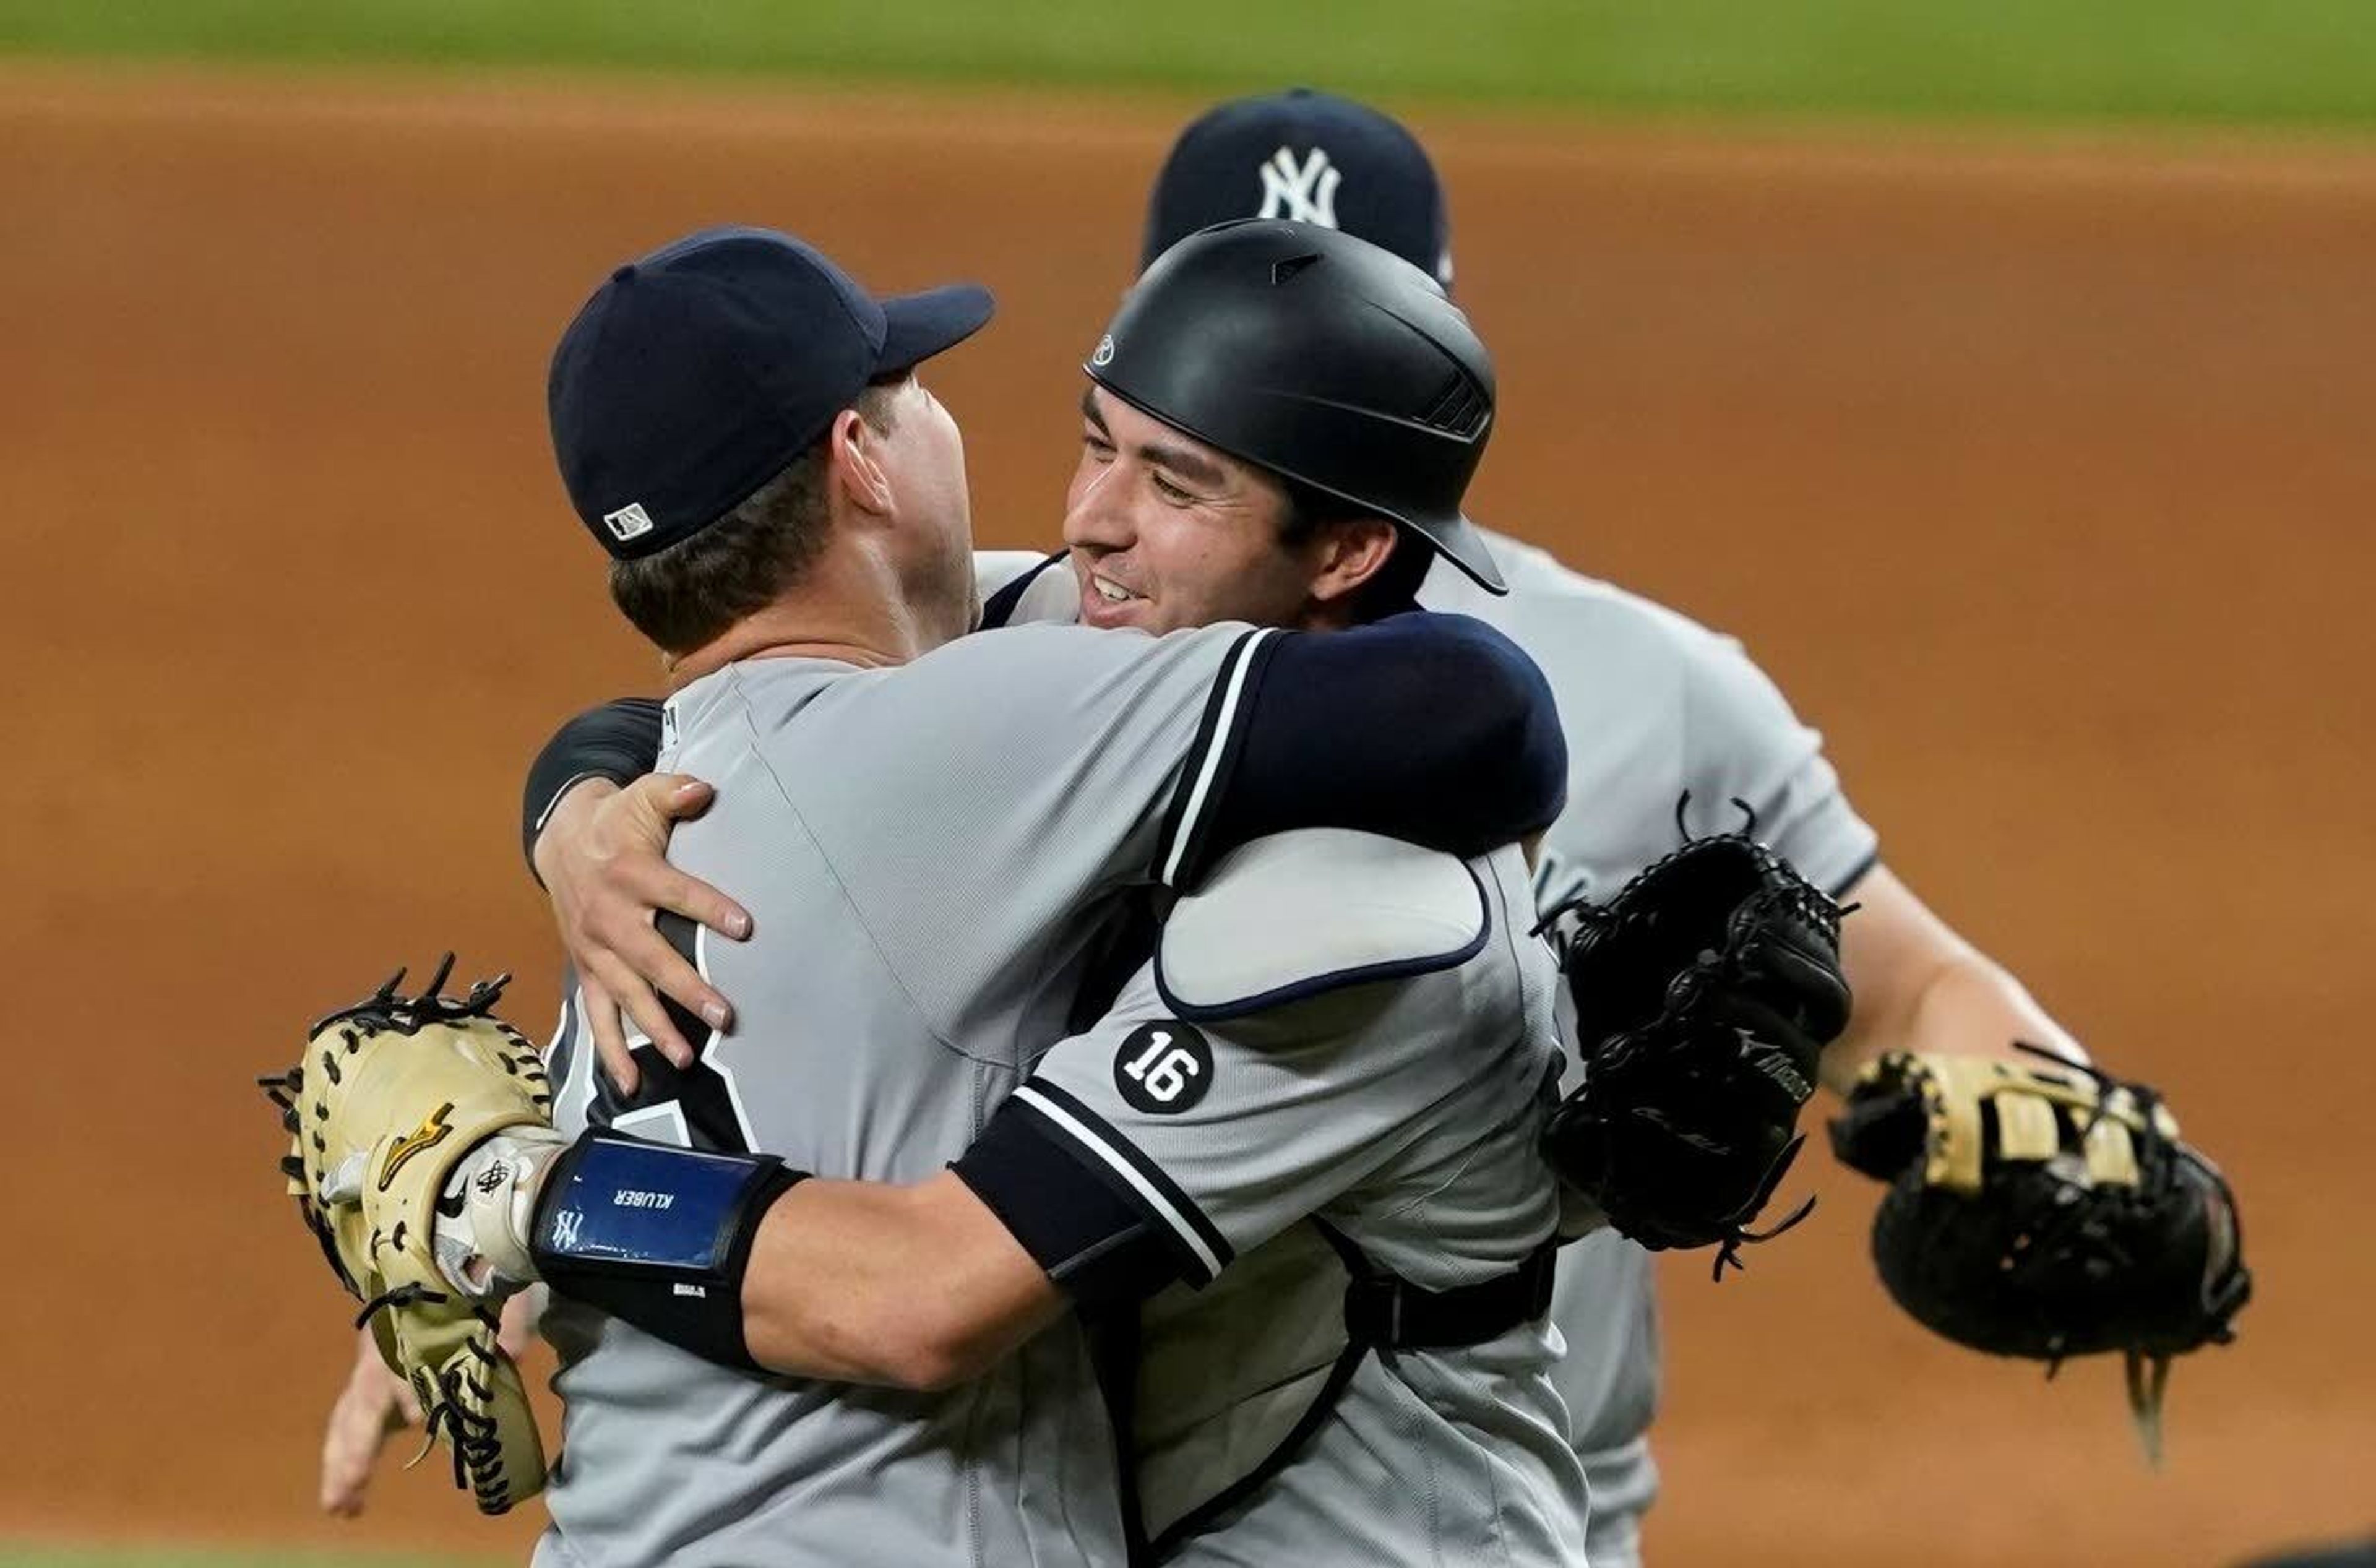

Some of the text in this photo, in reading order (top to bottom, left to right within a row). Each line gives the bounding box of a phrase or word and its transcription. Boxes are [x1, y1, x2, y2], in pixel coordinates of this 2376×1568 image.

[1257, 145, 1341, 230] NY
[1123, 1031, 1199, 1101] 16
[614, 1189, 674, 1209] KLUBER
[552, 1208, 583, 1251] NY
